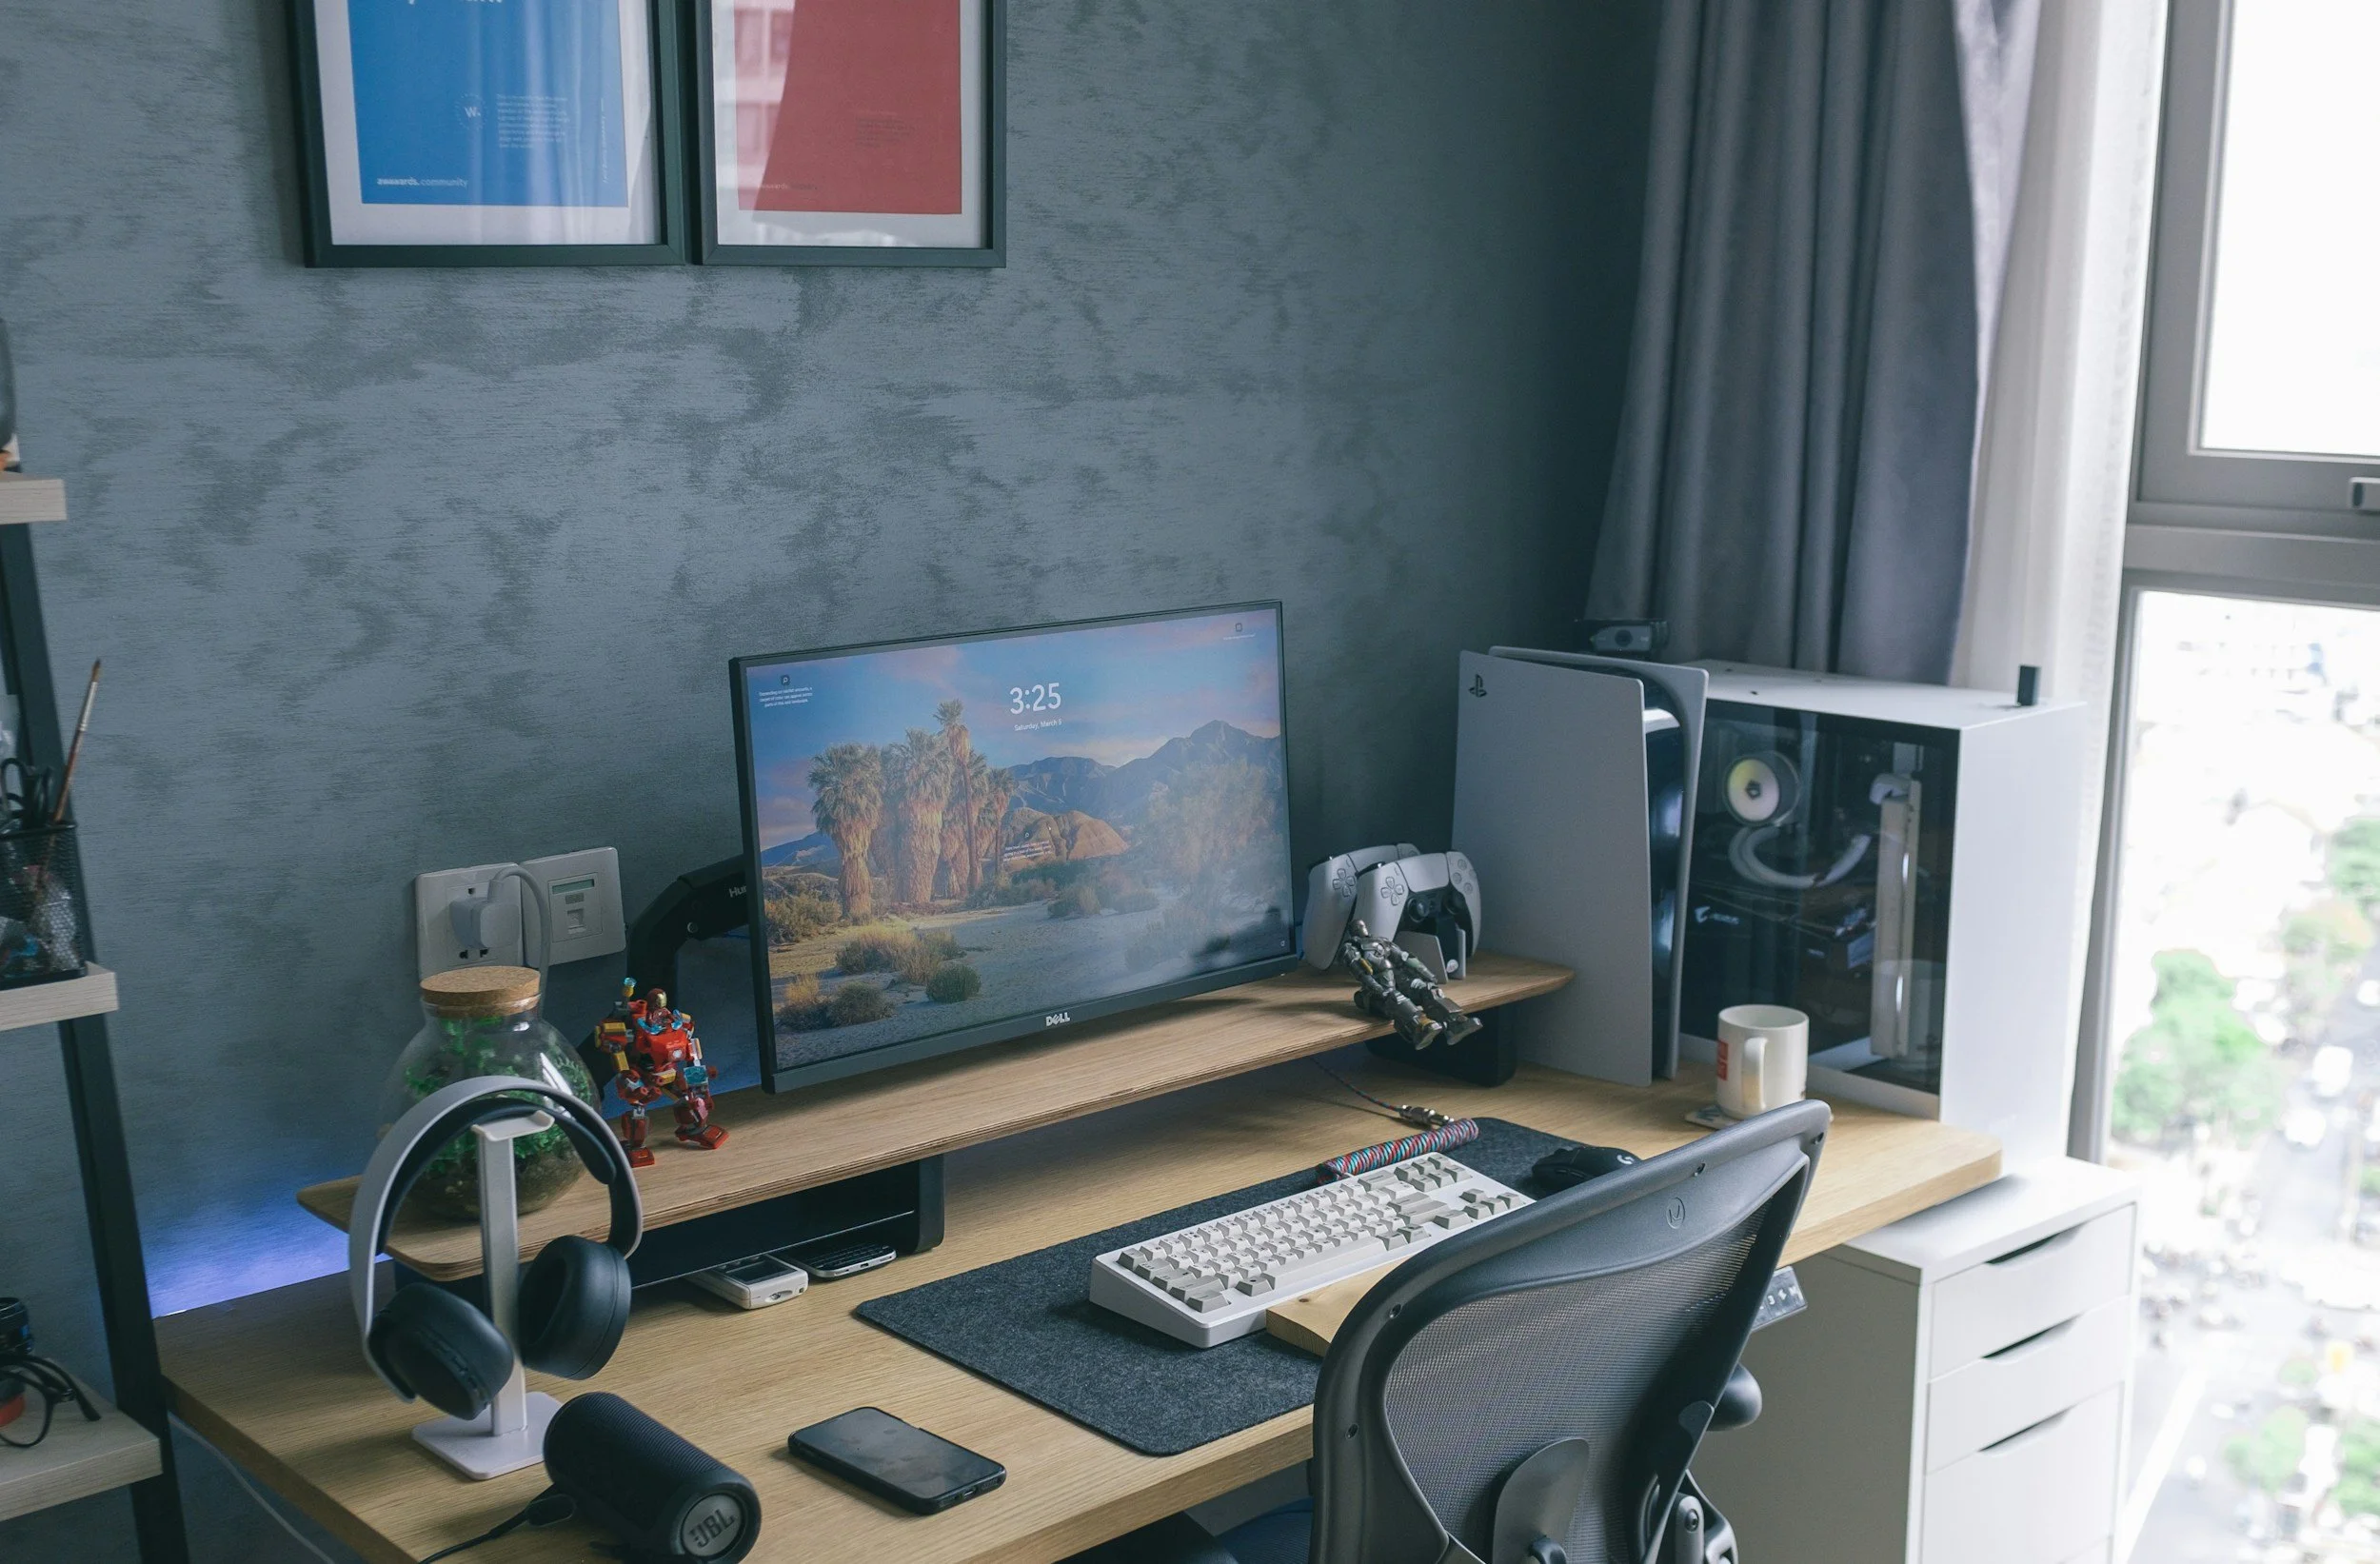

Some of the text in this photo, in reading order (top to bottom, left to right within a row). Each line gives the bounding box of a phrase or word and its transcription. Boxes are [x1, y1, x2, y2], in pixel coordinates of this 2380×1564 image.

[1009, 682, 1061, 715] 3:25
[1041, 719, 1058, 728] March
[1046, 1012, 1071, 1027] DELL
[688, 1509, 735, 1549] JBL
